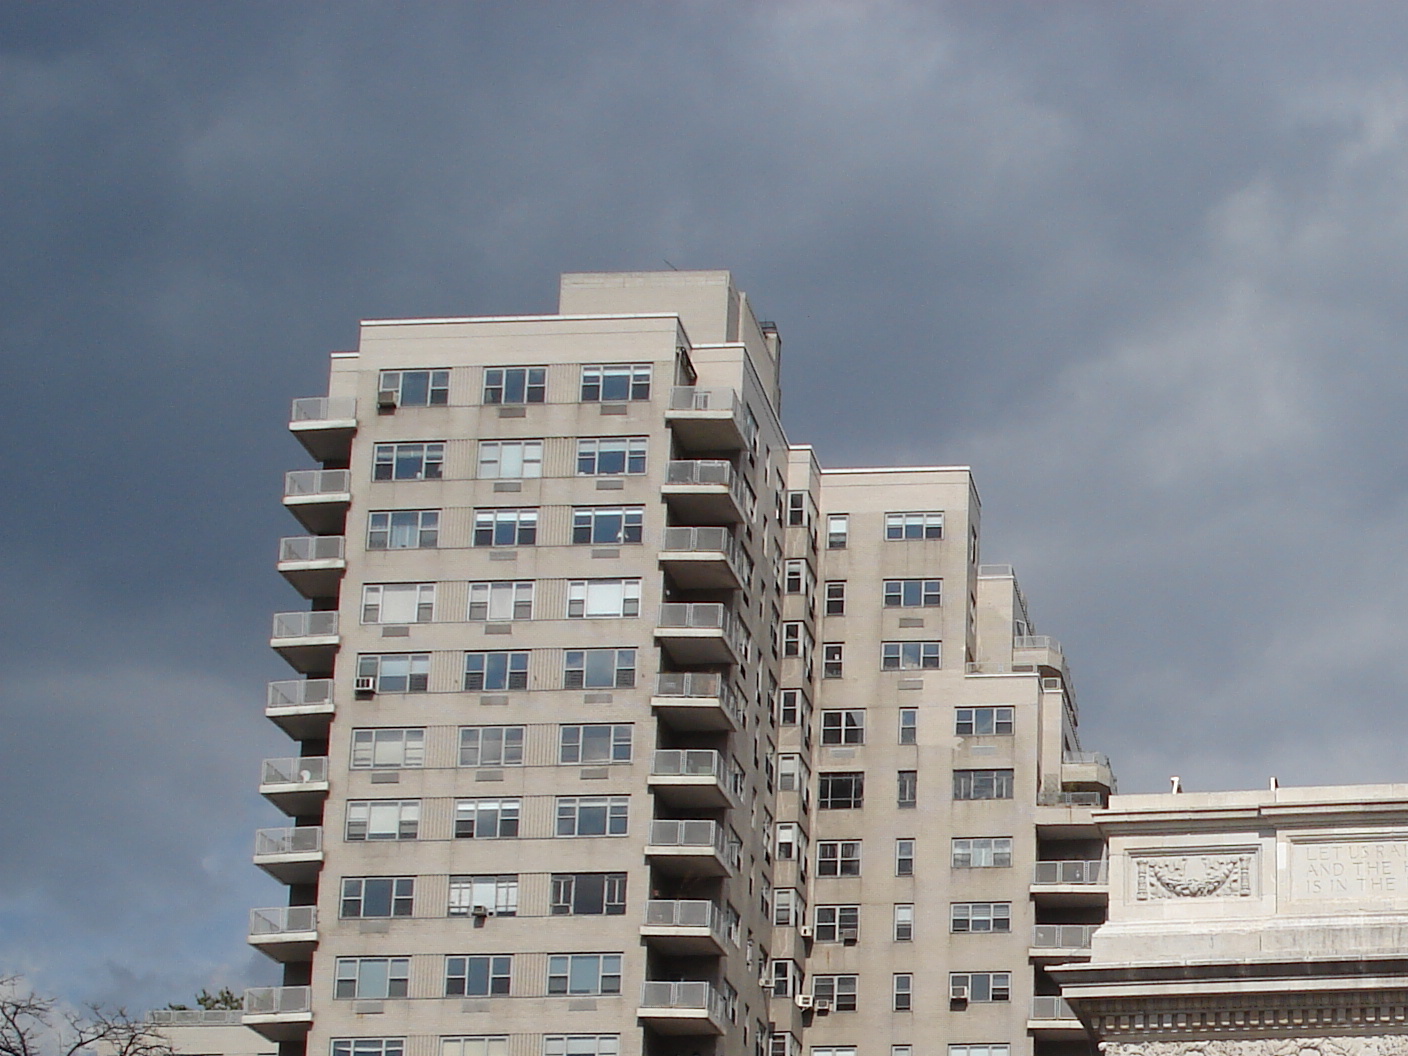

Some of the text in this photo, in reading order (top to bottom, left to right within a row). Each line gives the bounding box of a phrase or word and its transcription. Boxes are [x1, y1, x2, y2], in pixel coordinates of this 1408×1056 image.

[1307, 846, 1342, 860] LET
[1349, 845, 1369, 859] US
[1307, 862, 1344, 877] AND
[1353, 861, 1391, 875] THE
[1307, 880, 1322, 893] IS
[1330, 879, 1347, 892] IN
[1356, 878, 1395, 892] THE
